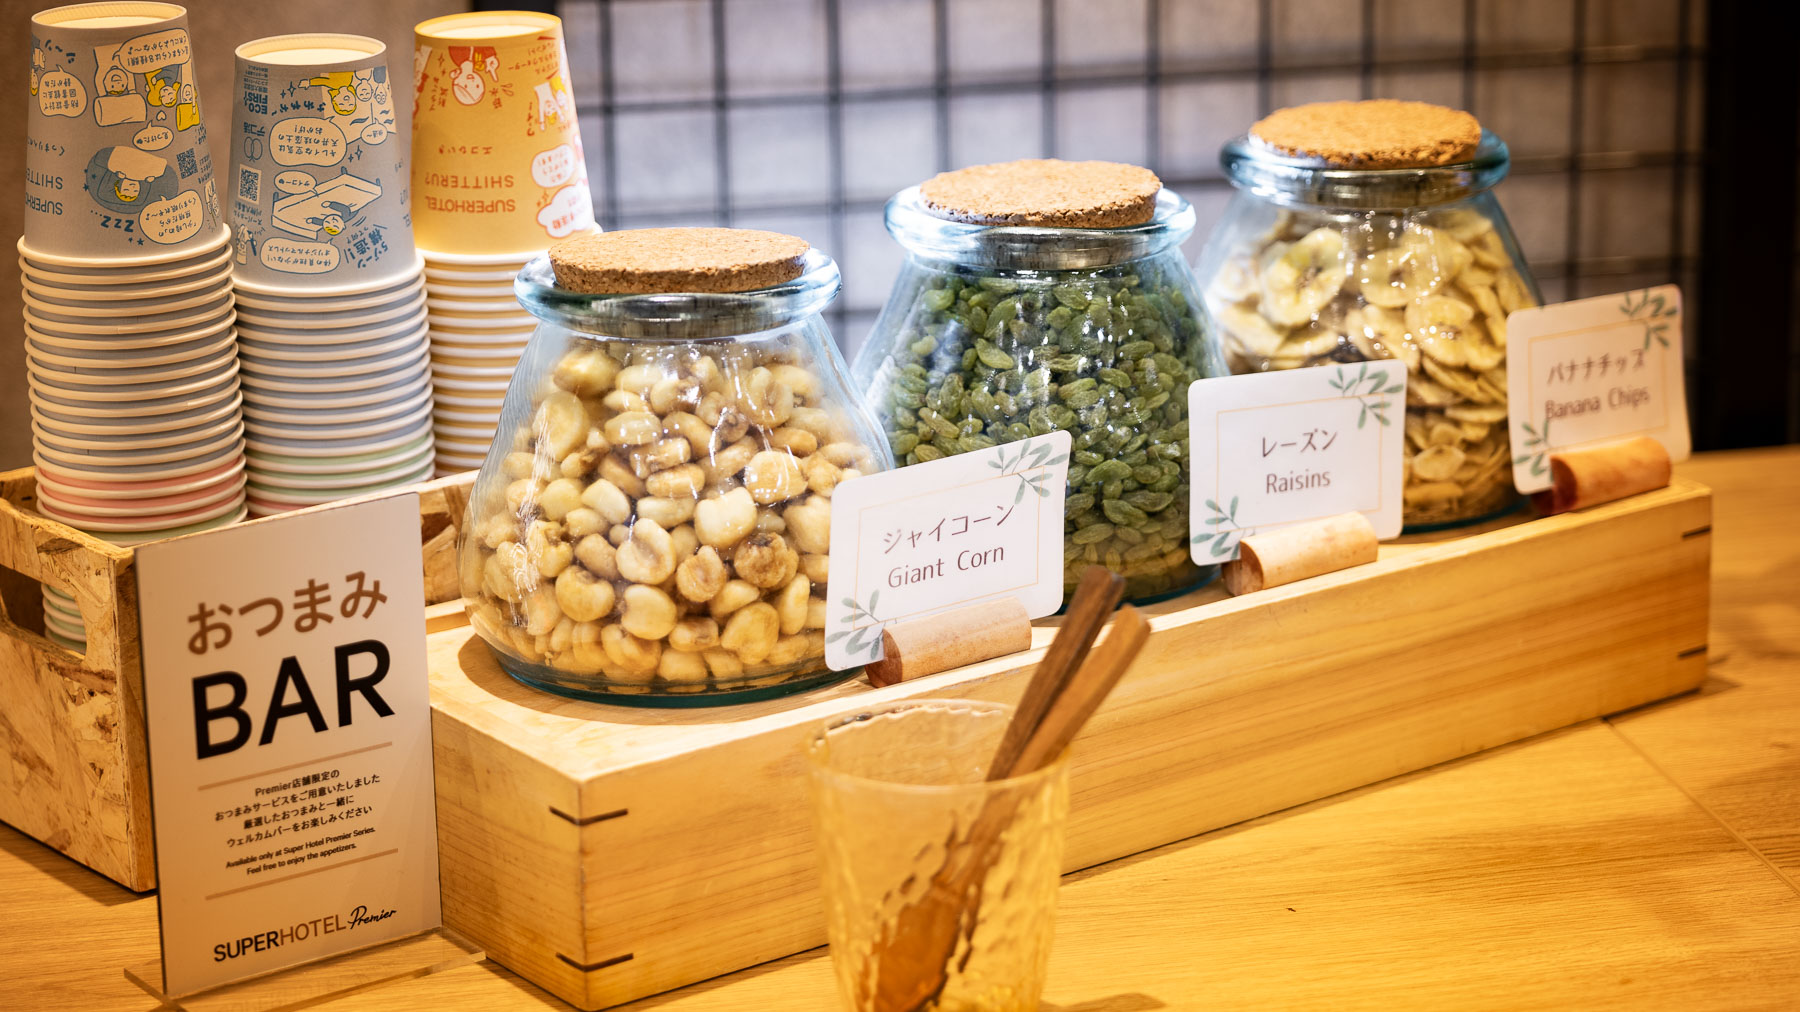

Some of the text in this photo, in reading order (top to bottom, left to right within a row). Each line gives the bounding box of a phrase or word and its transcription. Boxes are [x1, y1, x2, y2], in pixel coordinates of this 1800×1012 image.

[248, 102, 268, 115] ECO
[142, 131, 169, 145] 見つけた
[243, 121, 265, 137] デコ活
[278, 144, 337, 157] キレイな空気は
[438, 143, 493, 156] エコひいき
[424, 171, 514, 190] SHITTERU?
[424, 195, 516, 214] SUPERHOTEL
[268, 245, 331, 257] オリジナルマットレス
[1544, 384, 1650, 420] Banana Chips
[1262, 428, 1338, 458] レーズン
[1266, 468, 1331, 494] Raisins
[883, 504, 1015, 555] ジャイコーン
[887, 546, 1005, 589] Giant Corn
[187, 570, 388, 656] おつまみ
[191, 639, 396, 761] BAR
[215, 773, 381, 822] おつまみサービスをご用意いたしました
[254, 769, 340, 797] Premier店舗限定の
[226, 804, 373, 848] ウェルカムバーをお楽しみください
[243, 795, 355, 830] 厳選したおつまみと一緒に
[225, 854, 257, 869] Available
[258, 850, 275, 862] only
[275, 849, 283, 857] at
[283, 844, 304, 856] Super
[305, 838, 325, 849] Hotel
[325, 832, 352, 844] Premier
[246, 843, 357, 876] Feel free to enjoy the appetizers.
[347, 904, 397, 930] Premier
